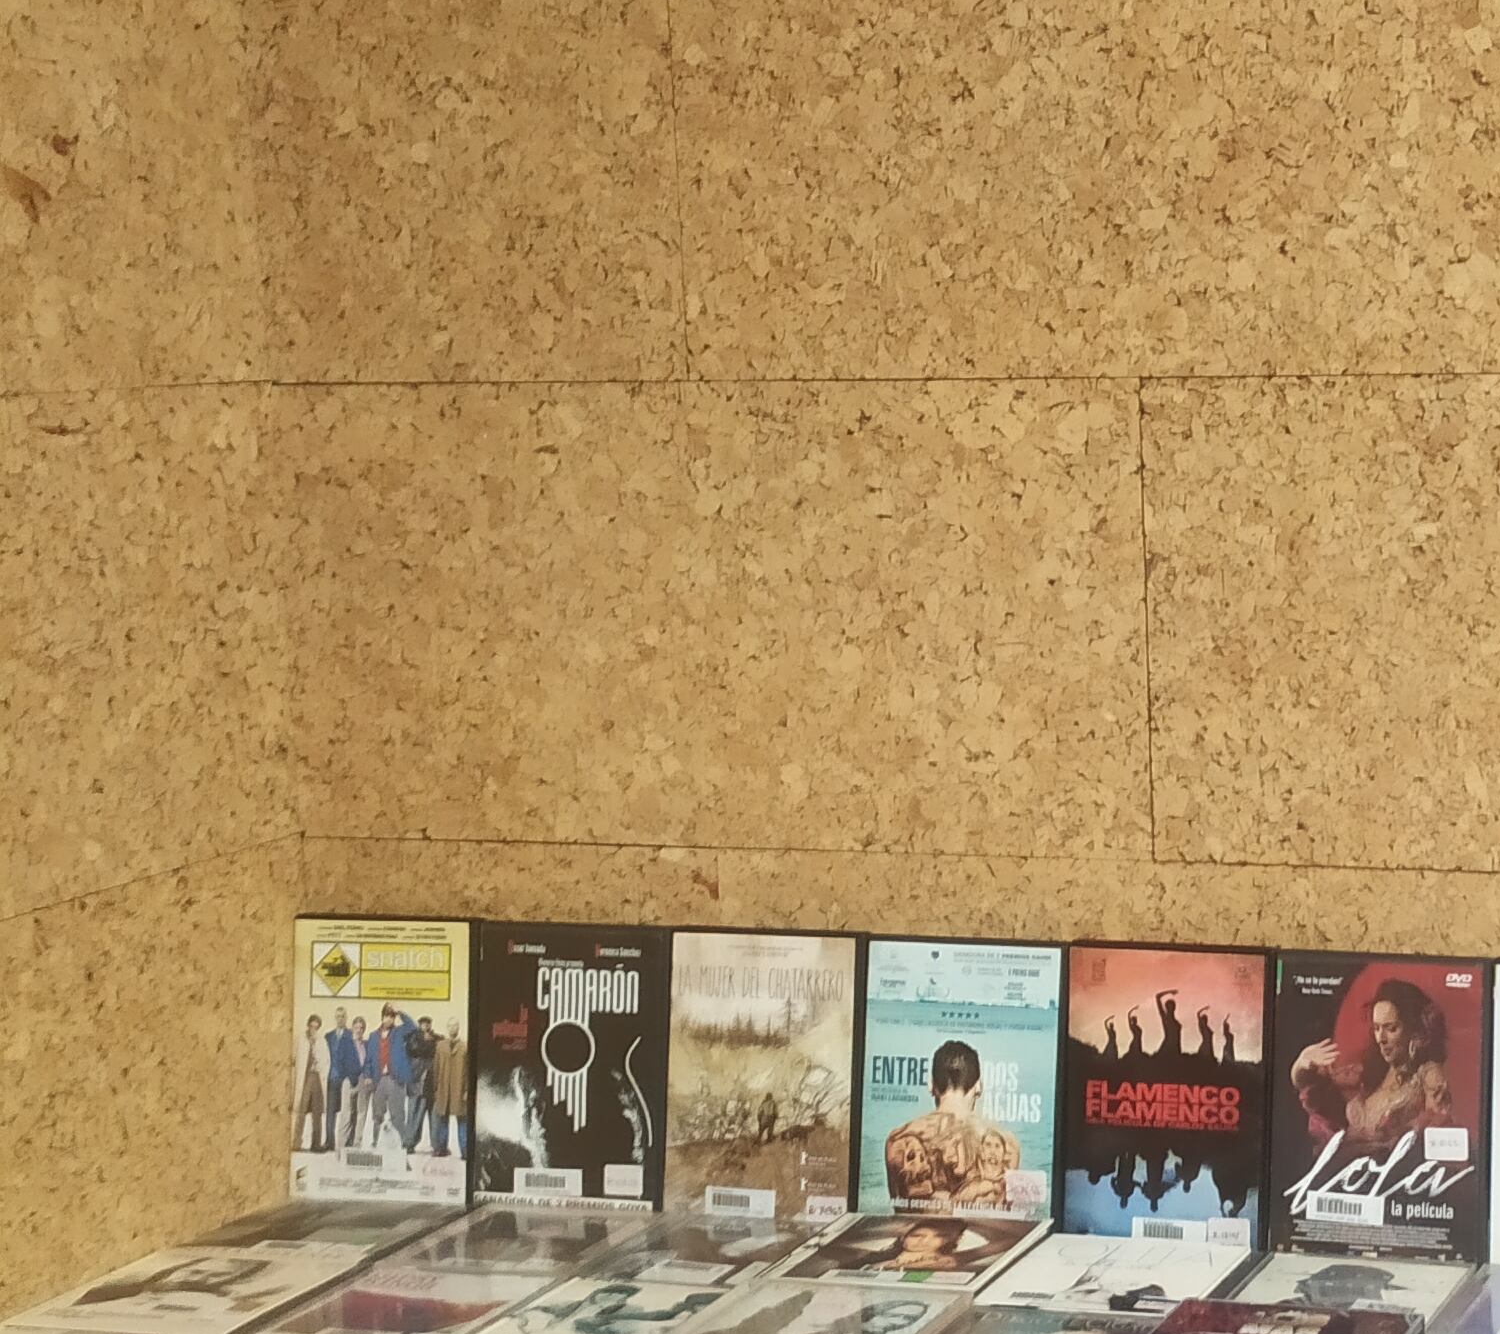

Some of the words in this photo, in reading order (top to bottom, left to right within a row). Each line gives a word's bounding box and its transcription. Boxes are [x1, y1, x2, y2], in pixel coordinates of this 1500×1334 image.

[367, 946, 445, 969] snatch
[537, 963, 639, 1018] CAMARÓN
[678, 964, 692, 997] LA
[699, 964, 735, 998] MUJER
[742, 966, 760, 998] DEL
[768, 967, 844, 1002] CHATARRERO
[871, 1055, 929, 1086] ENTRE
[1086, 1080, 1240, 1106] FLAMENCO
[982, 1093, 1042, 1123] AGUAS
[1086, 1099, 1240, 1124] FLAMENCO
[1391, 1200, 1402, 1216] la
[1406, 1200, 1454, 1220] película
